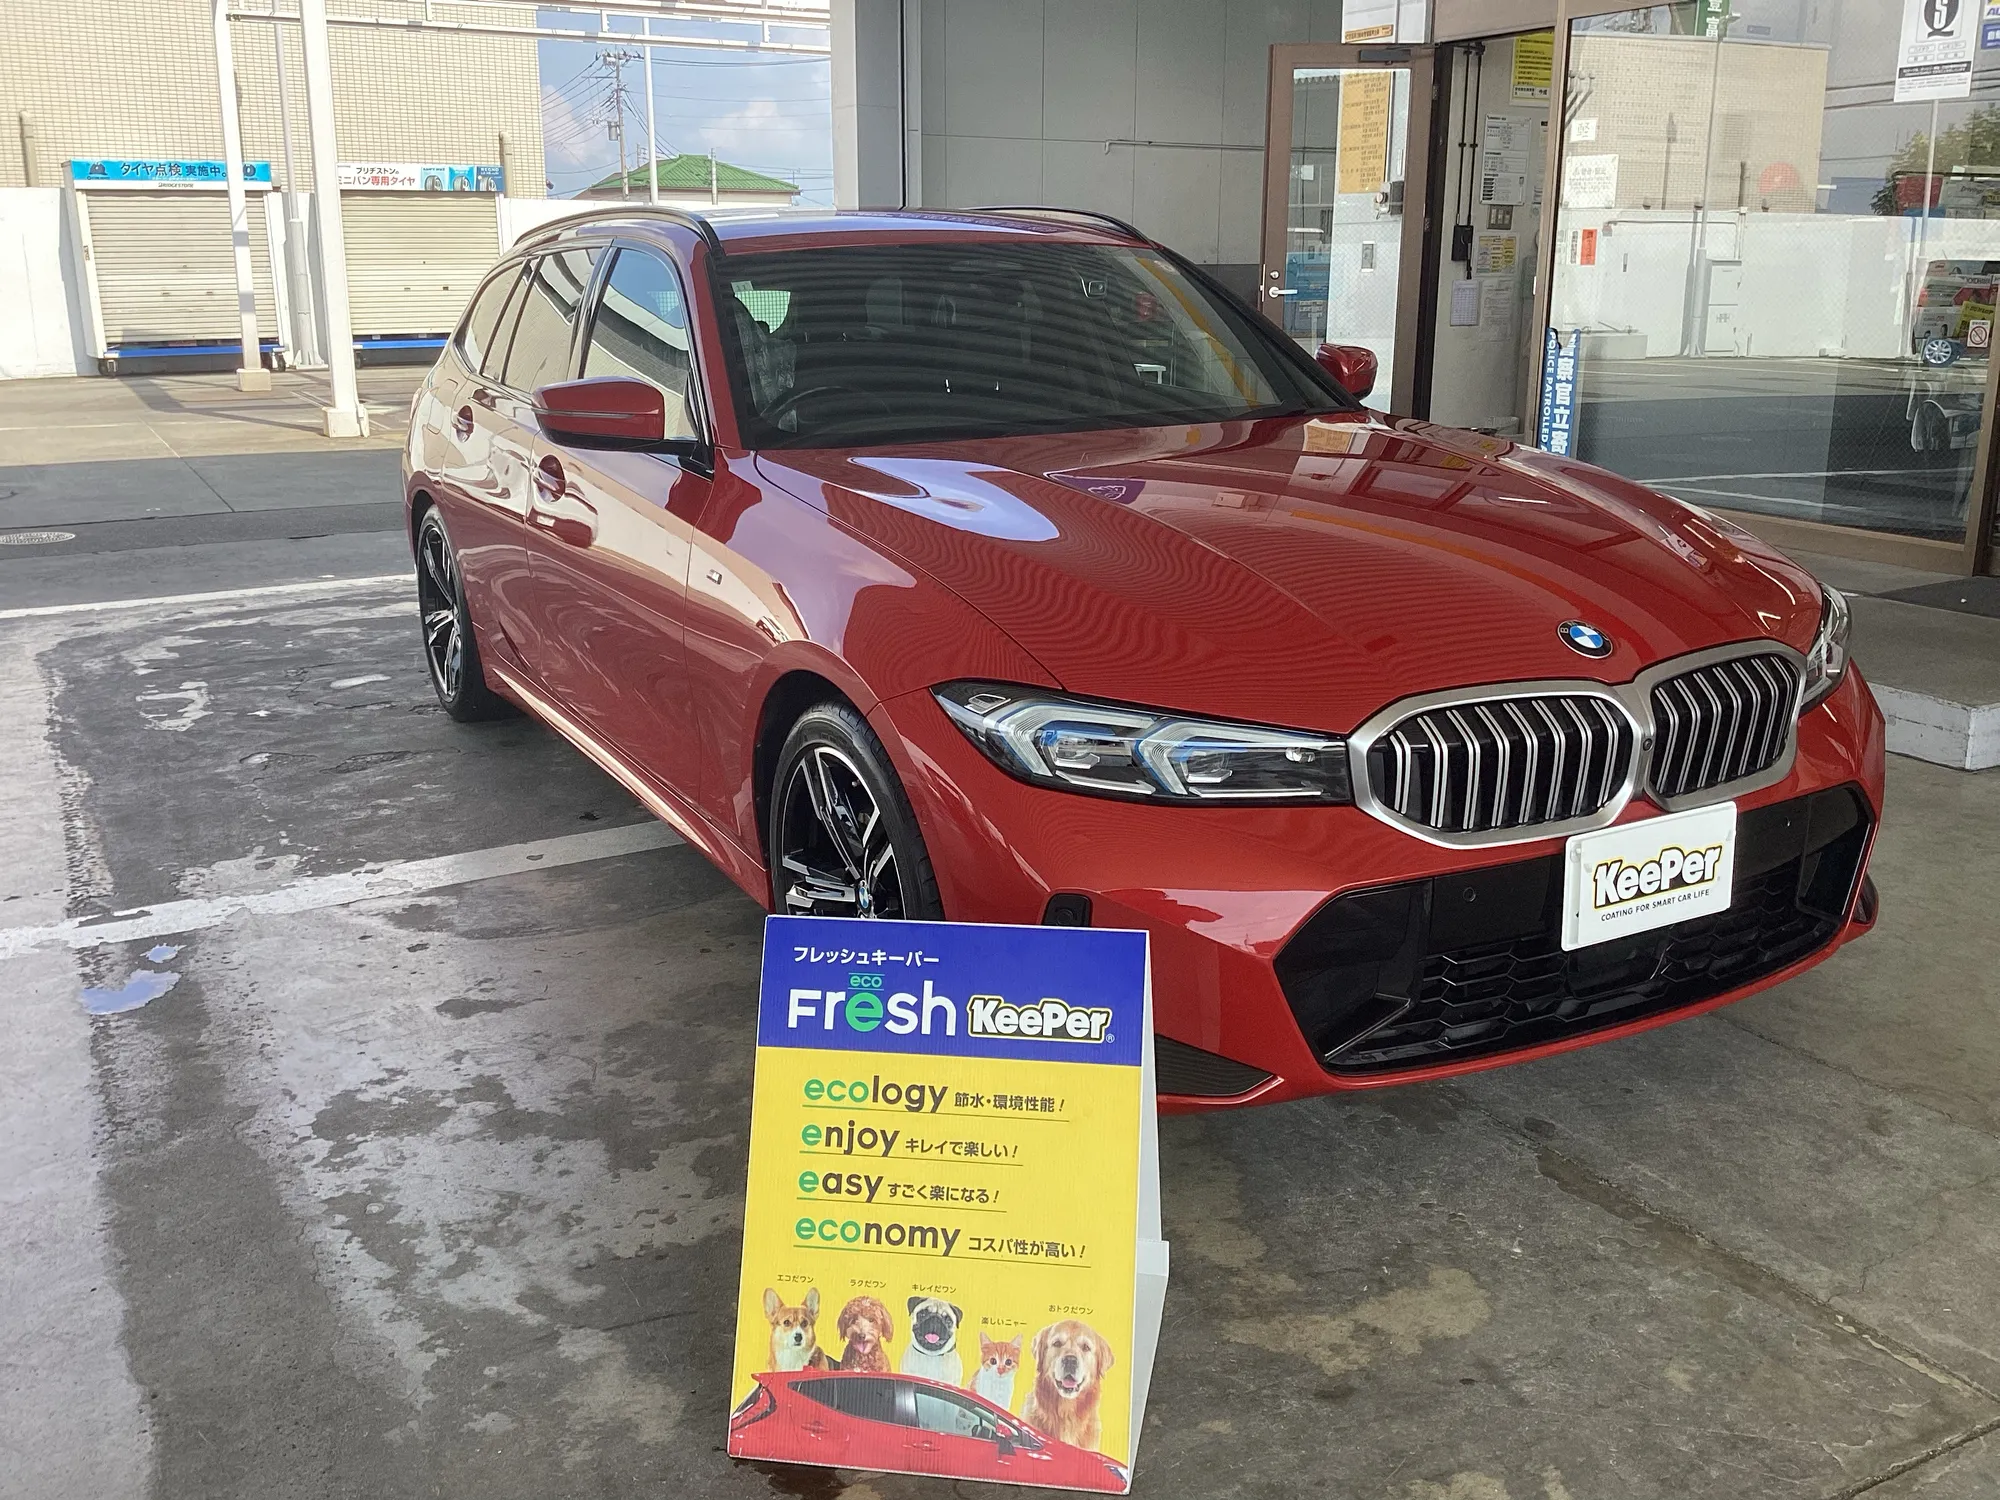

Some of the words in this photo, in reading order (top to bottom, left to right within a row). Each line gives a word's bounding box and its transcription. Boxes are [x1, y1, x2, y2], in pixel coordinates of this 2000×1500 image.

[1546, 331, 1557, 374] POLICE
[1540, 378, 1554, 443] PATROLLED
[1593, 844, 1722, 909] KeePer
[1601, 907, 1633, 921] COATING
[1635, 904, 1650, 914] FOR
[1652, 896, 1675, 909] SMART
[1677, 893, 1691, 903] CAR
[1693, 888, 1710, 899] LIFE
[793, 946, 940, 967] フレッシュキーパー
[850, 975, 882, 988] eco
[788, 980, 957, 1036] Fresh
[804, 1075, 949, 1113] ecology
[954, 1091, 1065, 1113] 節水・環境性能！
[801, 1119, 900, 1157] enjoy
[905, 1138, 1018, 1158] キレイで楽しい！
[798, 1170, 884, 1203] easy
[887, 1183, 1000, 1204] すごく楽になる！
[795, 1217, 961, 1257] economy
[968, 1236, 1086, 1259] コスパ性が高い！
[776, 1273, 814, 1284] エコだワン
[849, 1278, 887, 1289] ラクだワン
[911, 1283, 957, 1294] キレイだワン
[980, 1316, 1028, 1327] 楽しいニャー
[1048, 1304, 1094, 1315] おトクだワン
